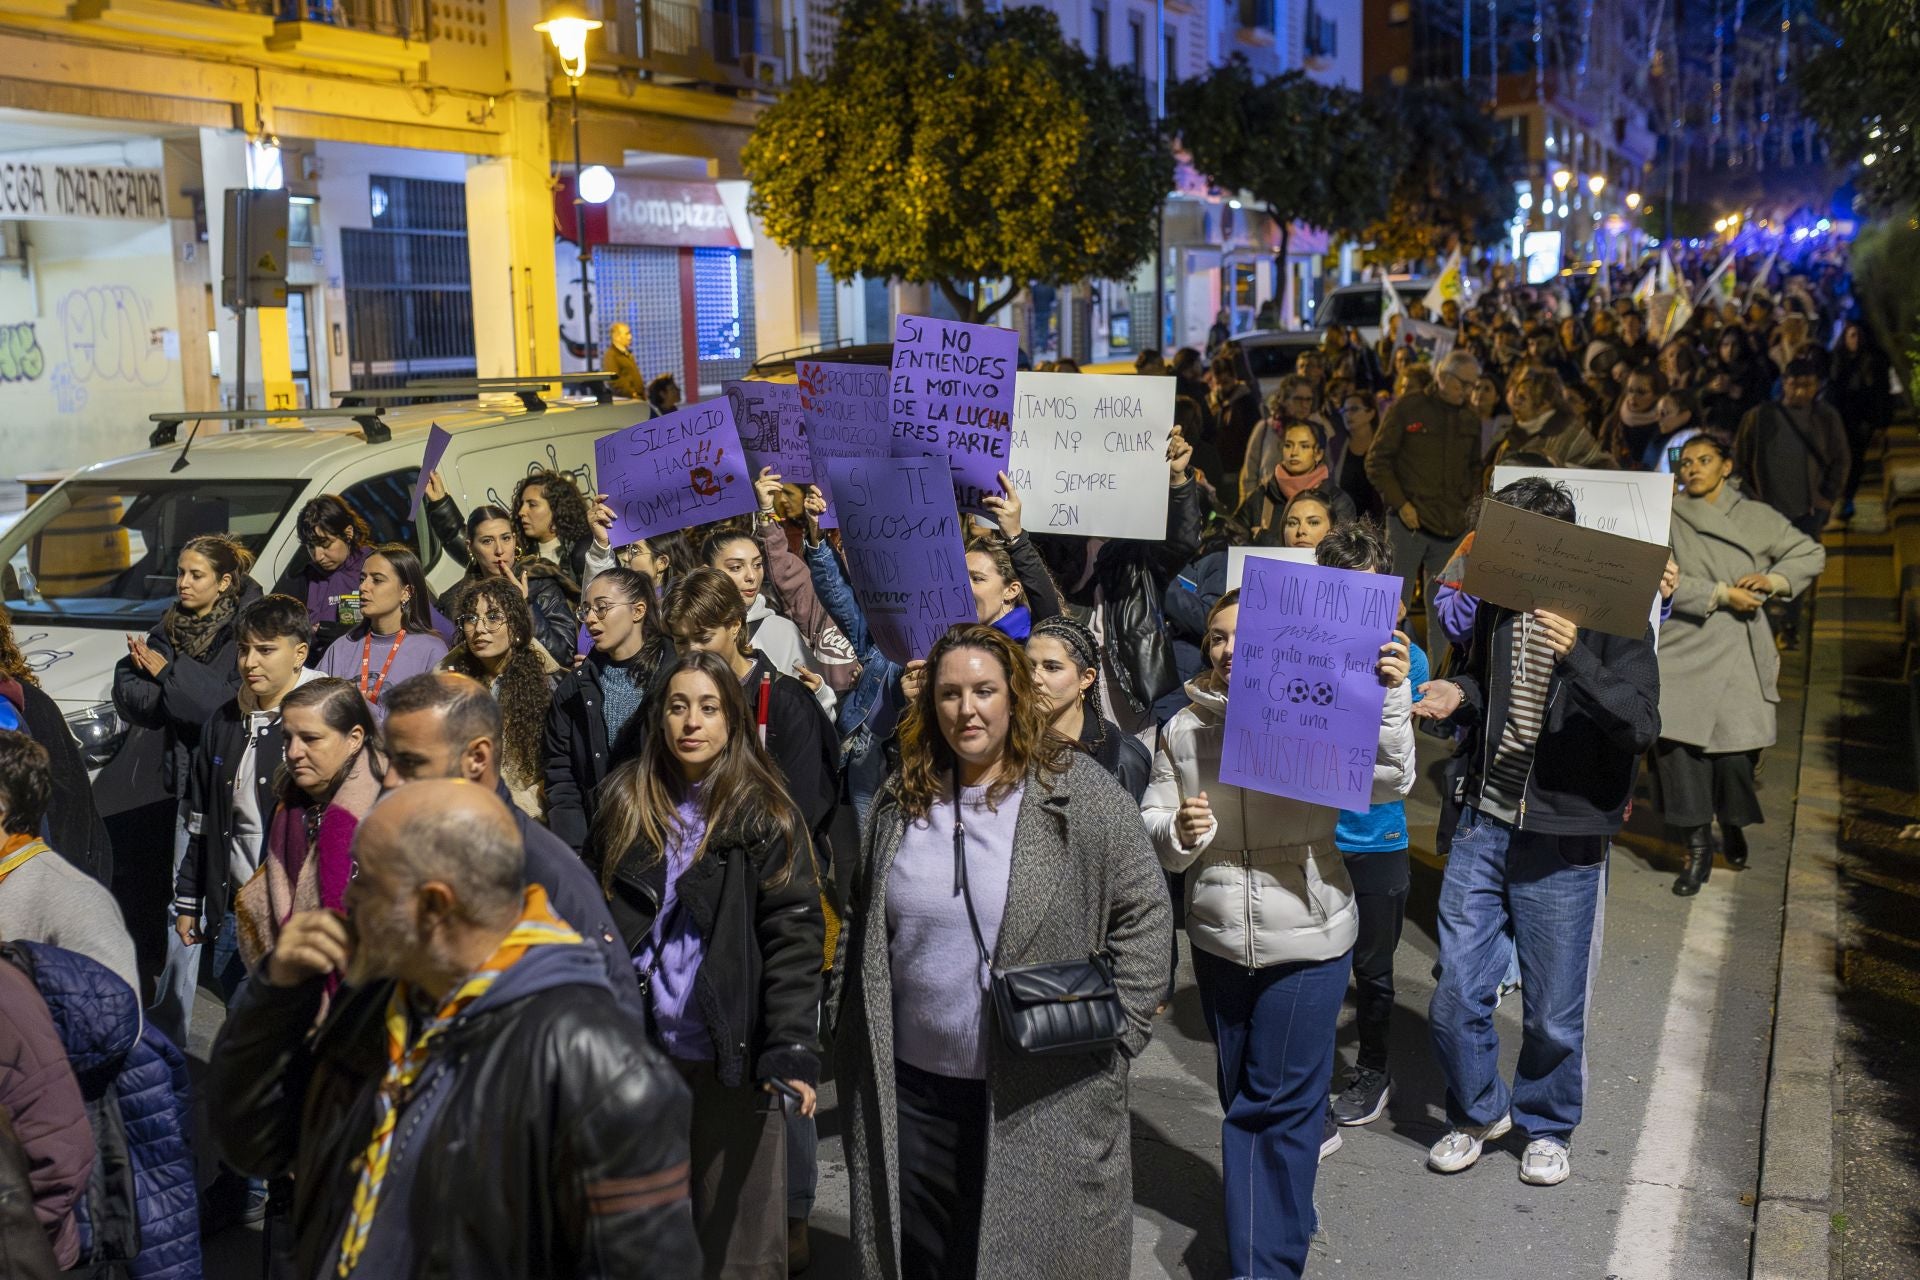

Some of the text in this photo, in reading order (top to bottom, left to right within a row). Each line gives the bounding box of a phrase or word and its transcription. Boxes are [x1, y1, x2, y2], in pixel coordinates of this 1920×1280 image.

[614, 190, 730, 233] Rompizza
[896, 318, 972, 353] SI NO
[894, 349, 1008, 380] ENTIENDES
[803, 364, 889, 398] YO PROTESTO
[893, 375, 999, 399] EL MOTIVO
[808, 397, 889, 423] PORQUE NO
[893, 399, 1011, 433] DE LA LUCHA
[1093, 395, 1144, 420] AHORA
[597, 409, 725, 466] TU SILENCIO
[813, 424, 877, 446] CONOZCO
[891, 421, 1005, 459] ERES PARTE
[1103, 429, 1155, 453] CALLAR
[609, 472, 635, 497] TE
[848, 467, 874, 507] SI
[897, 467, 935, 505] TE
[1054, 470, 1118, 494] SIEMPRE
[846, 514, 957, 542] acosan
[1048, 503, 1079, 527] 25N
[926, 547, 955, 583] UN
[919, 587, 947, 621] ASÍ
[1244, 569, 1396, 631] ES UN PAÍS TAN
[1267, 623, 1356, 646] pobre
[1241, 641, 1265, 666] que
[1271, 644, 1302, 672] grita
[1307, 652, 1337, 670] más
[1244, 675, 1260, 691] un
[1261, 705, 1329, 732] que una
[1234, 728, 1371, 792] INJUSTICIA 25
[1348, 769, 1364, 793] N
